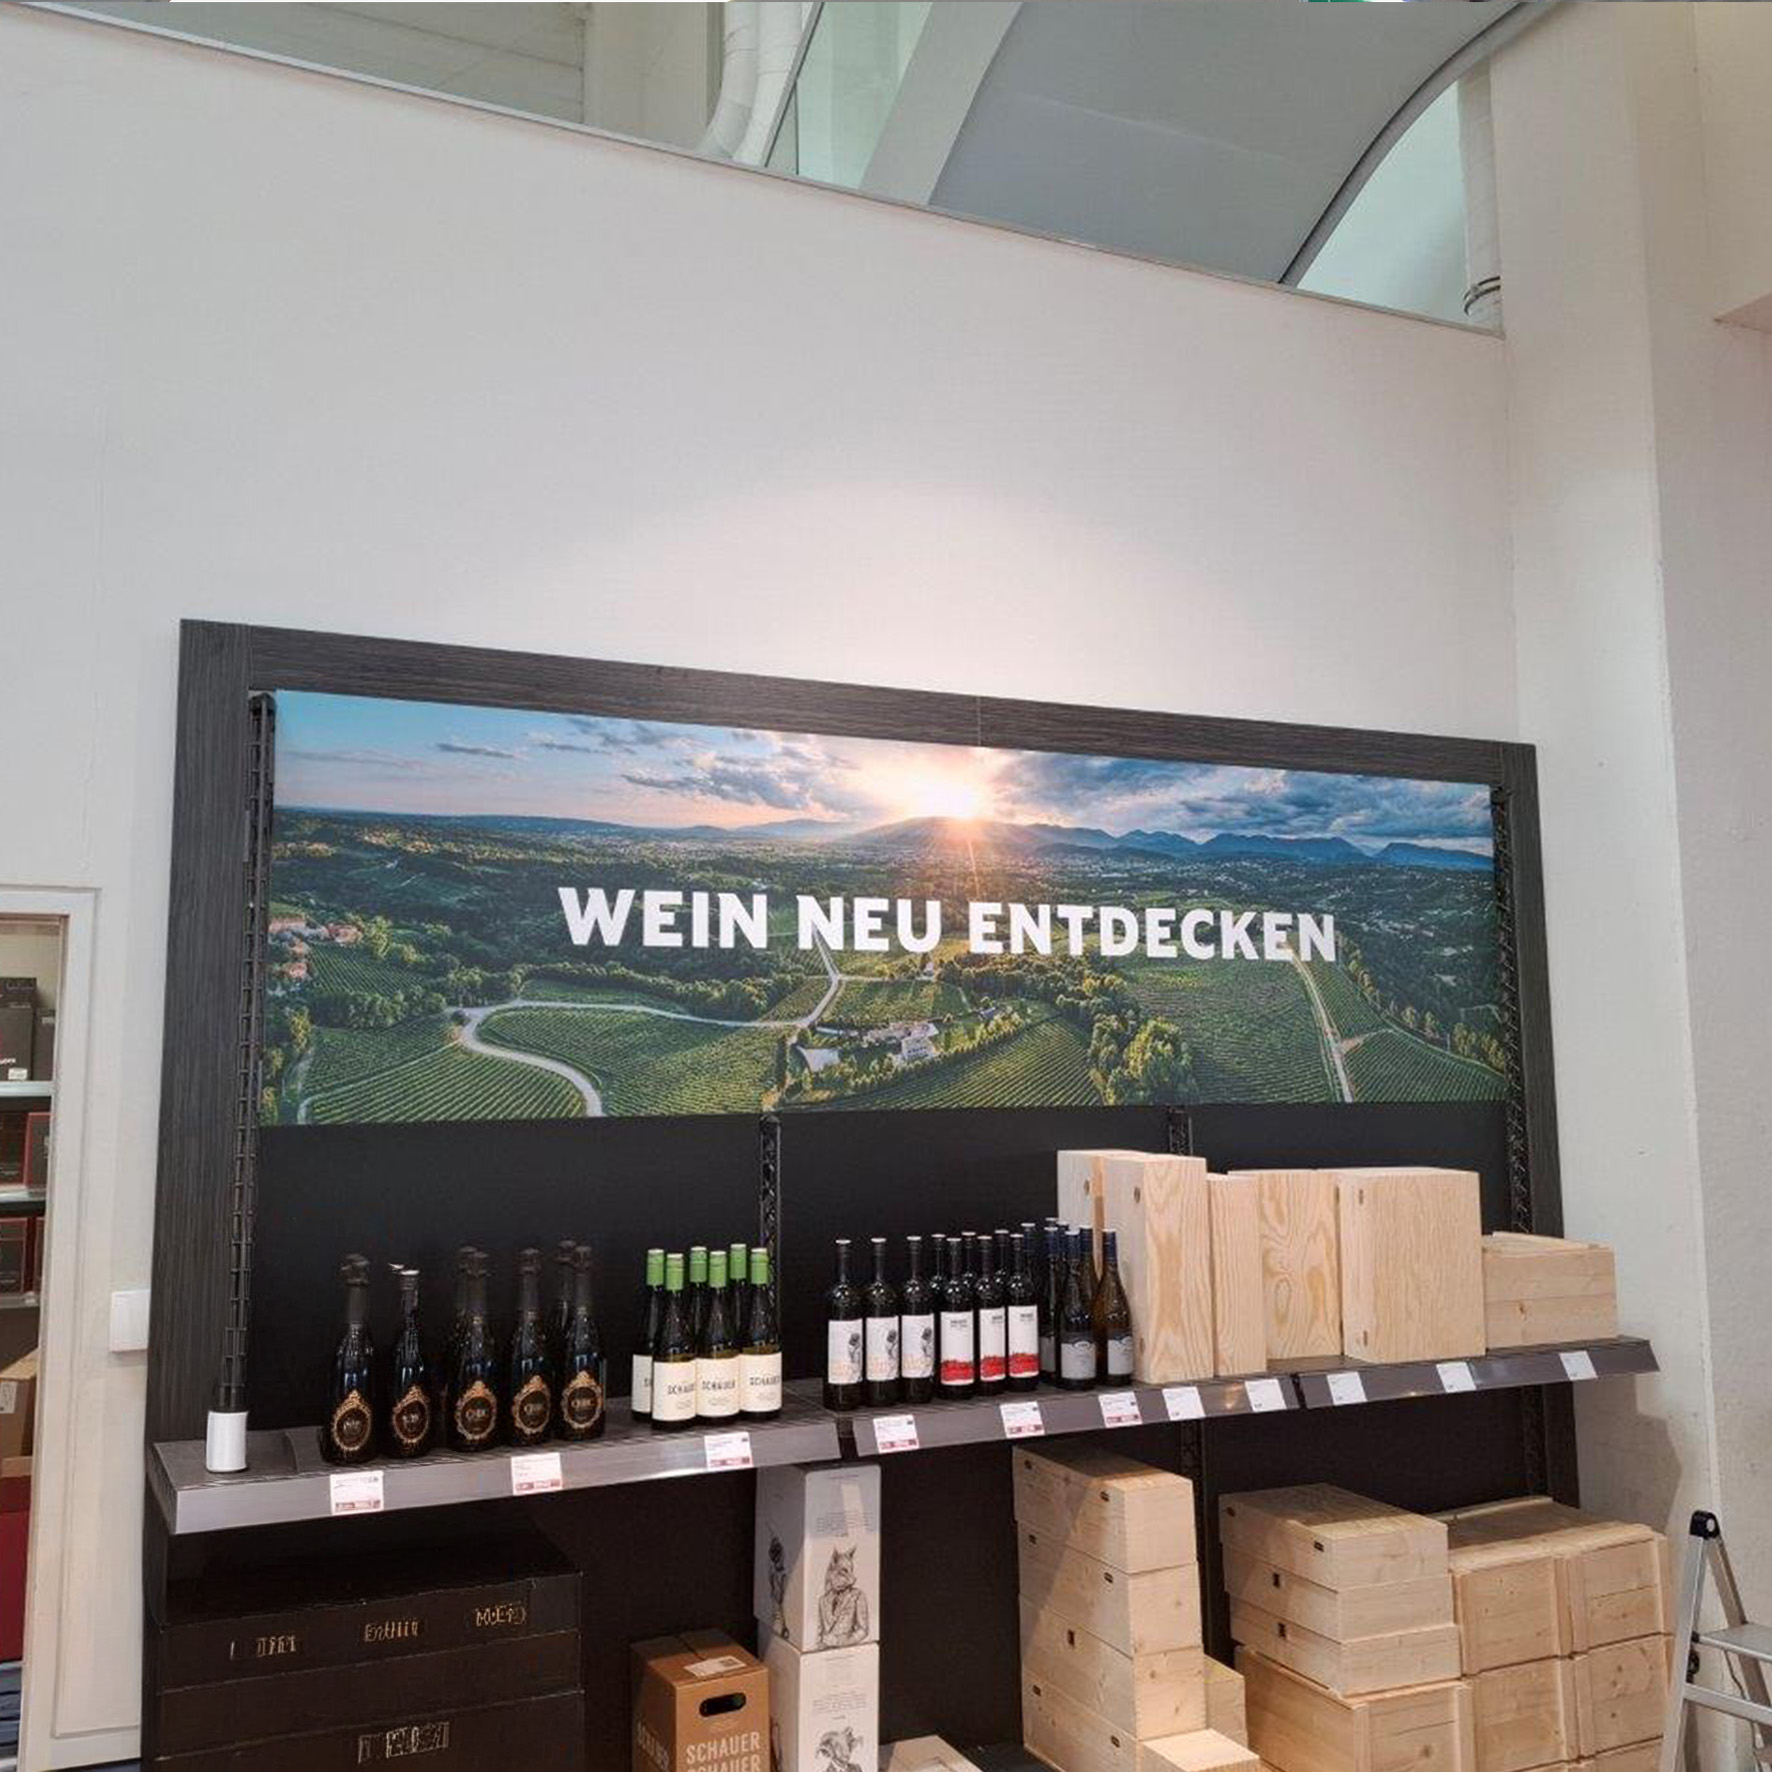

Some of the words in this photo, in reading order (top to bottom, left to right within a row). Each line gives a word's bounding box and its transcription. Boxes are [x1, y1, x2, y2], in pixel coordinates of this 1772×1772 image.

[557, 887, 768, 949] WEIN
[796, 894, 941, 953] NEU
[969, 901, 1337, 962] ENTDECKEN
[686, 1731, 760, 1765] SCHAUER
[686, 1754, 760, 1772] CHAUER
